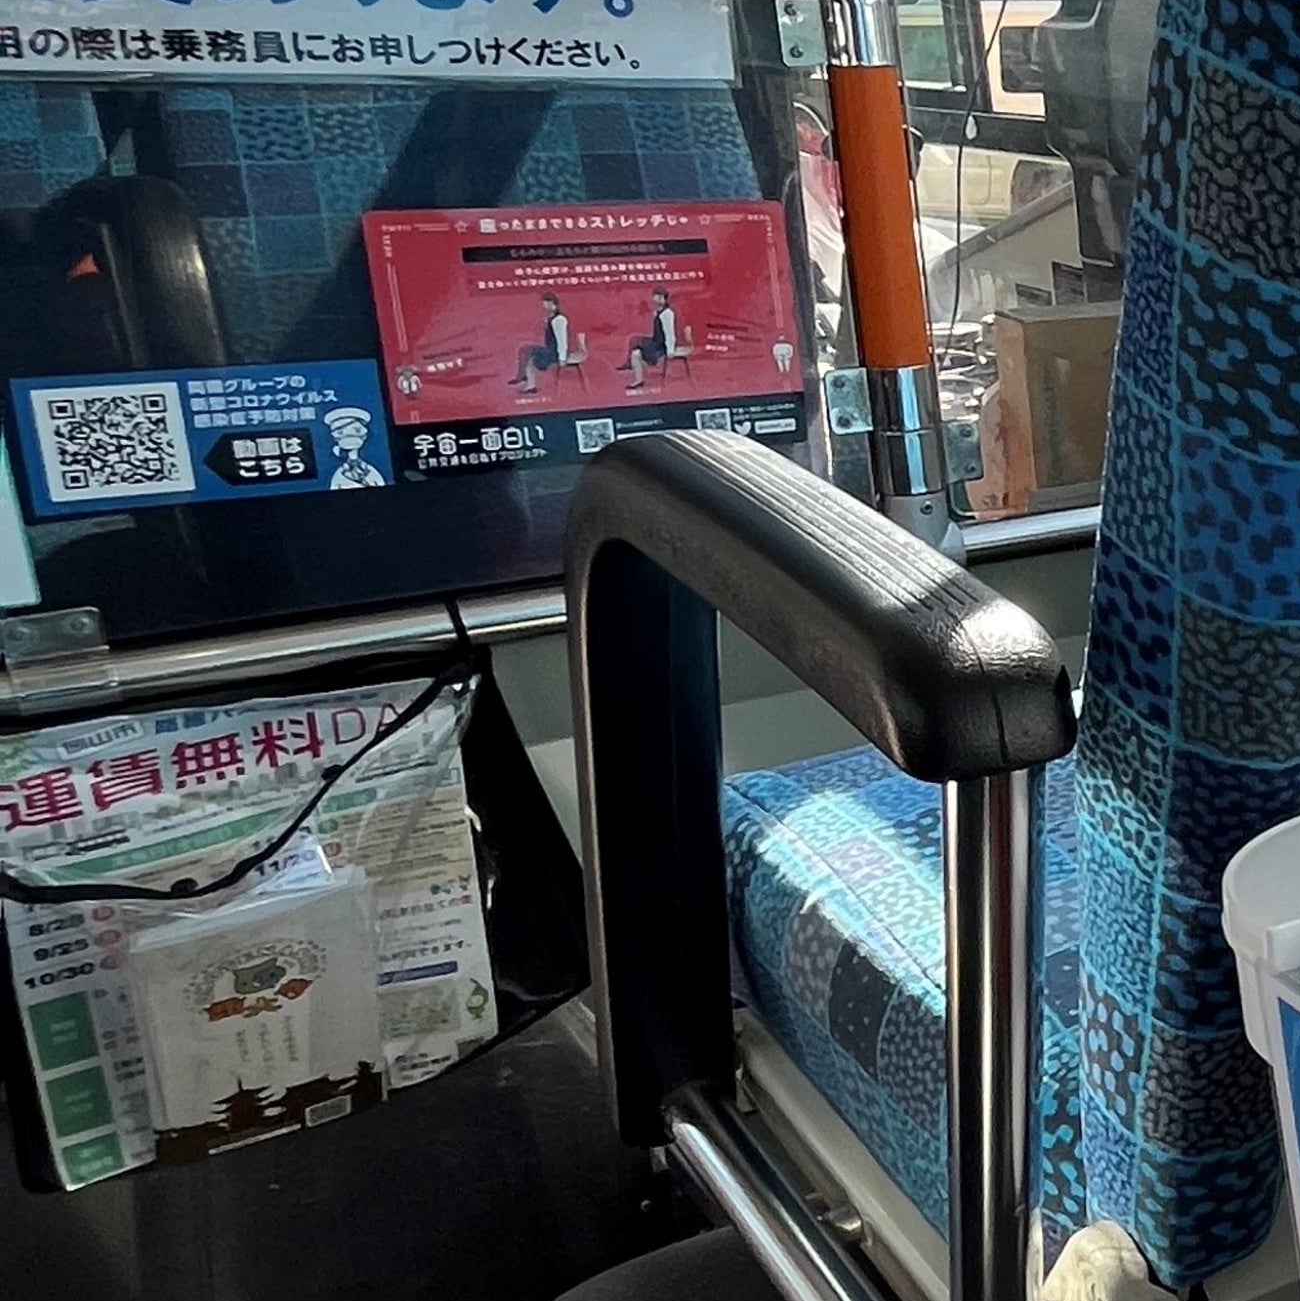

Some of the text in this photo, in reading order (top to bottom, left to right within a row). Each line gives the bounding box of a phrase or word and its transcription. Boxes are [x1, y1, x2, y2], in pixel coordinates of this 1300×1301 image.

[412, 424, 545, 458] 宇宙一面白い
[237, 456, 306, 479] こちら
